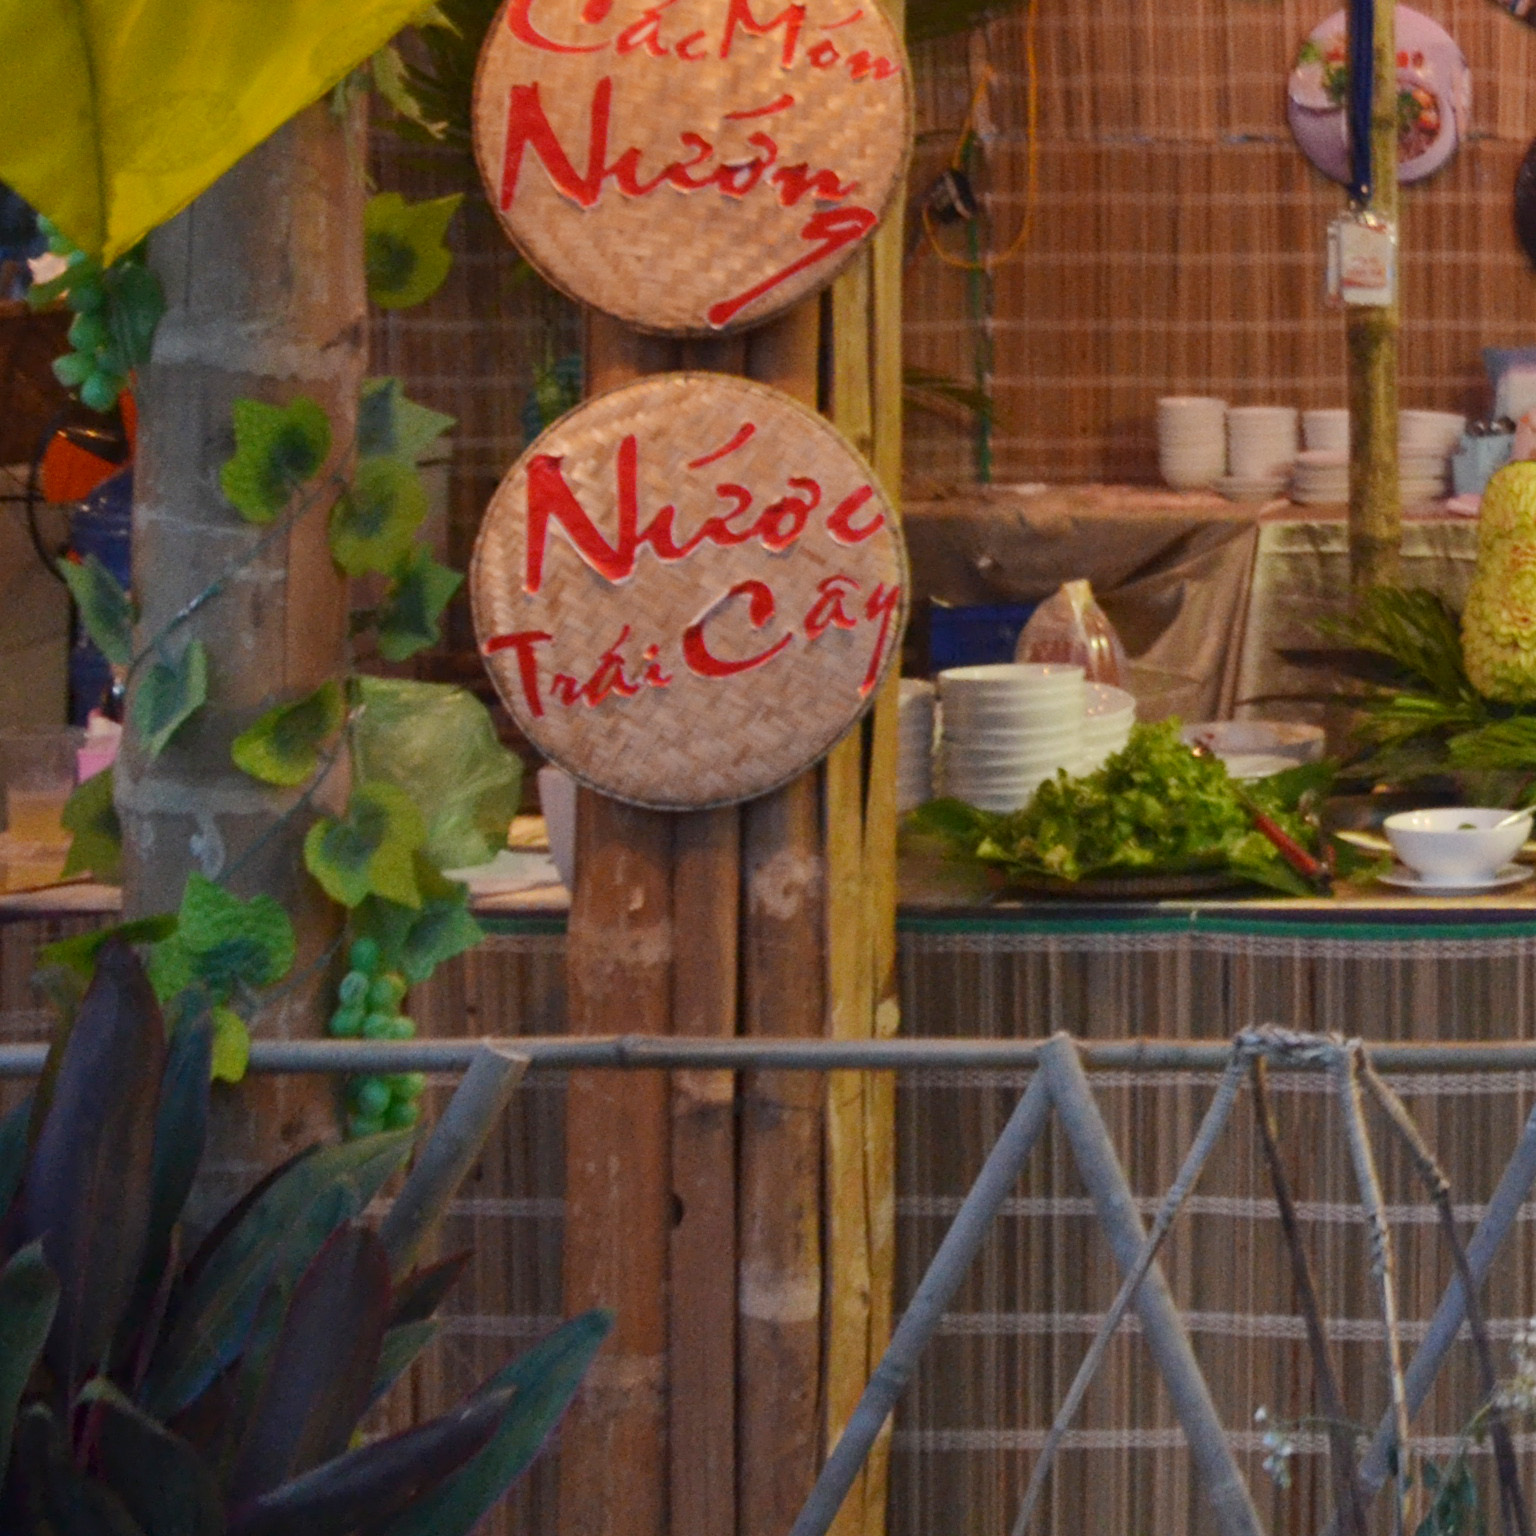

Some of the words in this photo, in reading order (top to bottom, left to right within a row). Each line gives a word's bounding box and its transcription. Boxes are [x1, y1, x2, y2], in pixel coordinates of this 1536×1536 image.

[500, 75, 879, 330] Nướng
[523, 421, 886, 594] Nước
[481, 623, 673, 718] Trái
[681, 573, 900, 699] Cây
